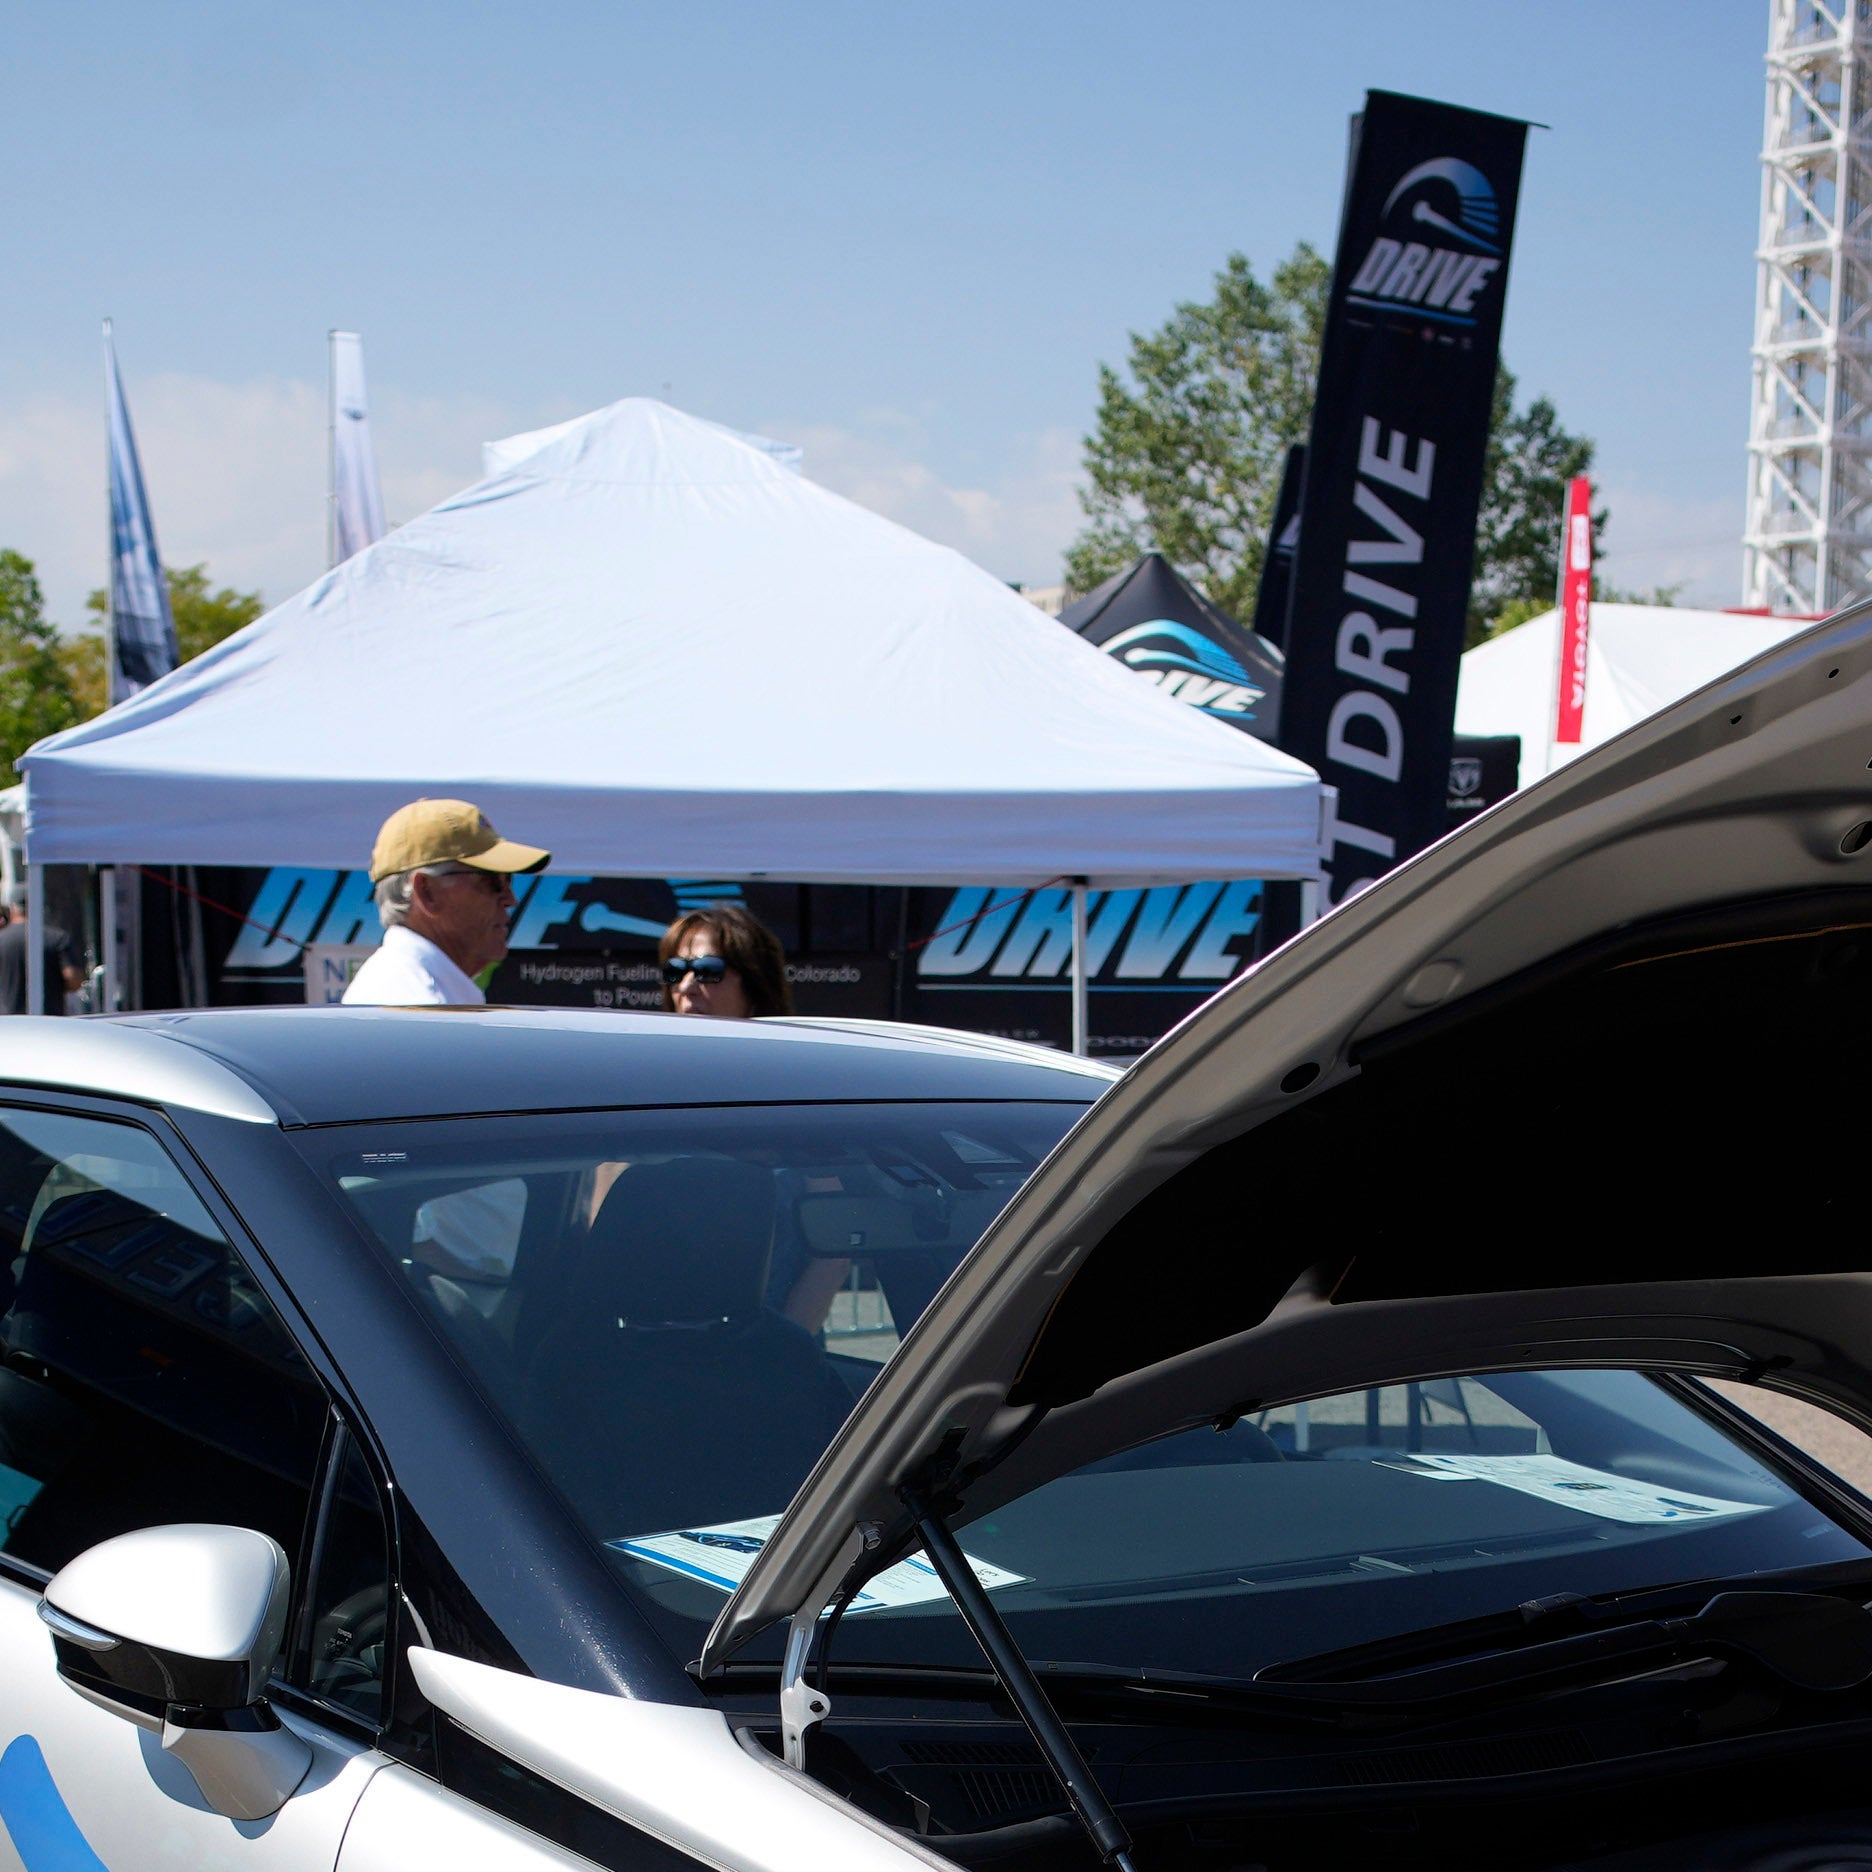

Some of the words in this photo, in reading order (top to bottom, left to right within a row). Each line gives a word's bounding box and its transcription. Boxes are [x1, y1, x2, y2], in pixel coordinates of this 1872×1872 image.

[1348, 237, 1500, 312] DRIVE
[1328, 415, 1436, 783] DRIVE
[920, 879, 1264, 979] DRIVE
[520, 963, 603, 985] Hydrogen
[608, 963, 663, 983] Fuelin
[785, 963, 861, 983] Colorado
[593, 989, 611, 1006] to
[616, 989, 664, 1007] Powe
